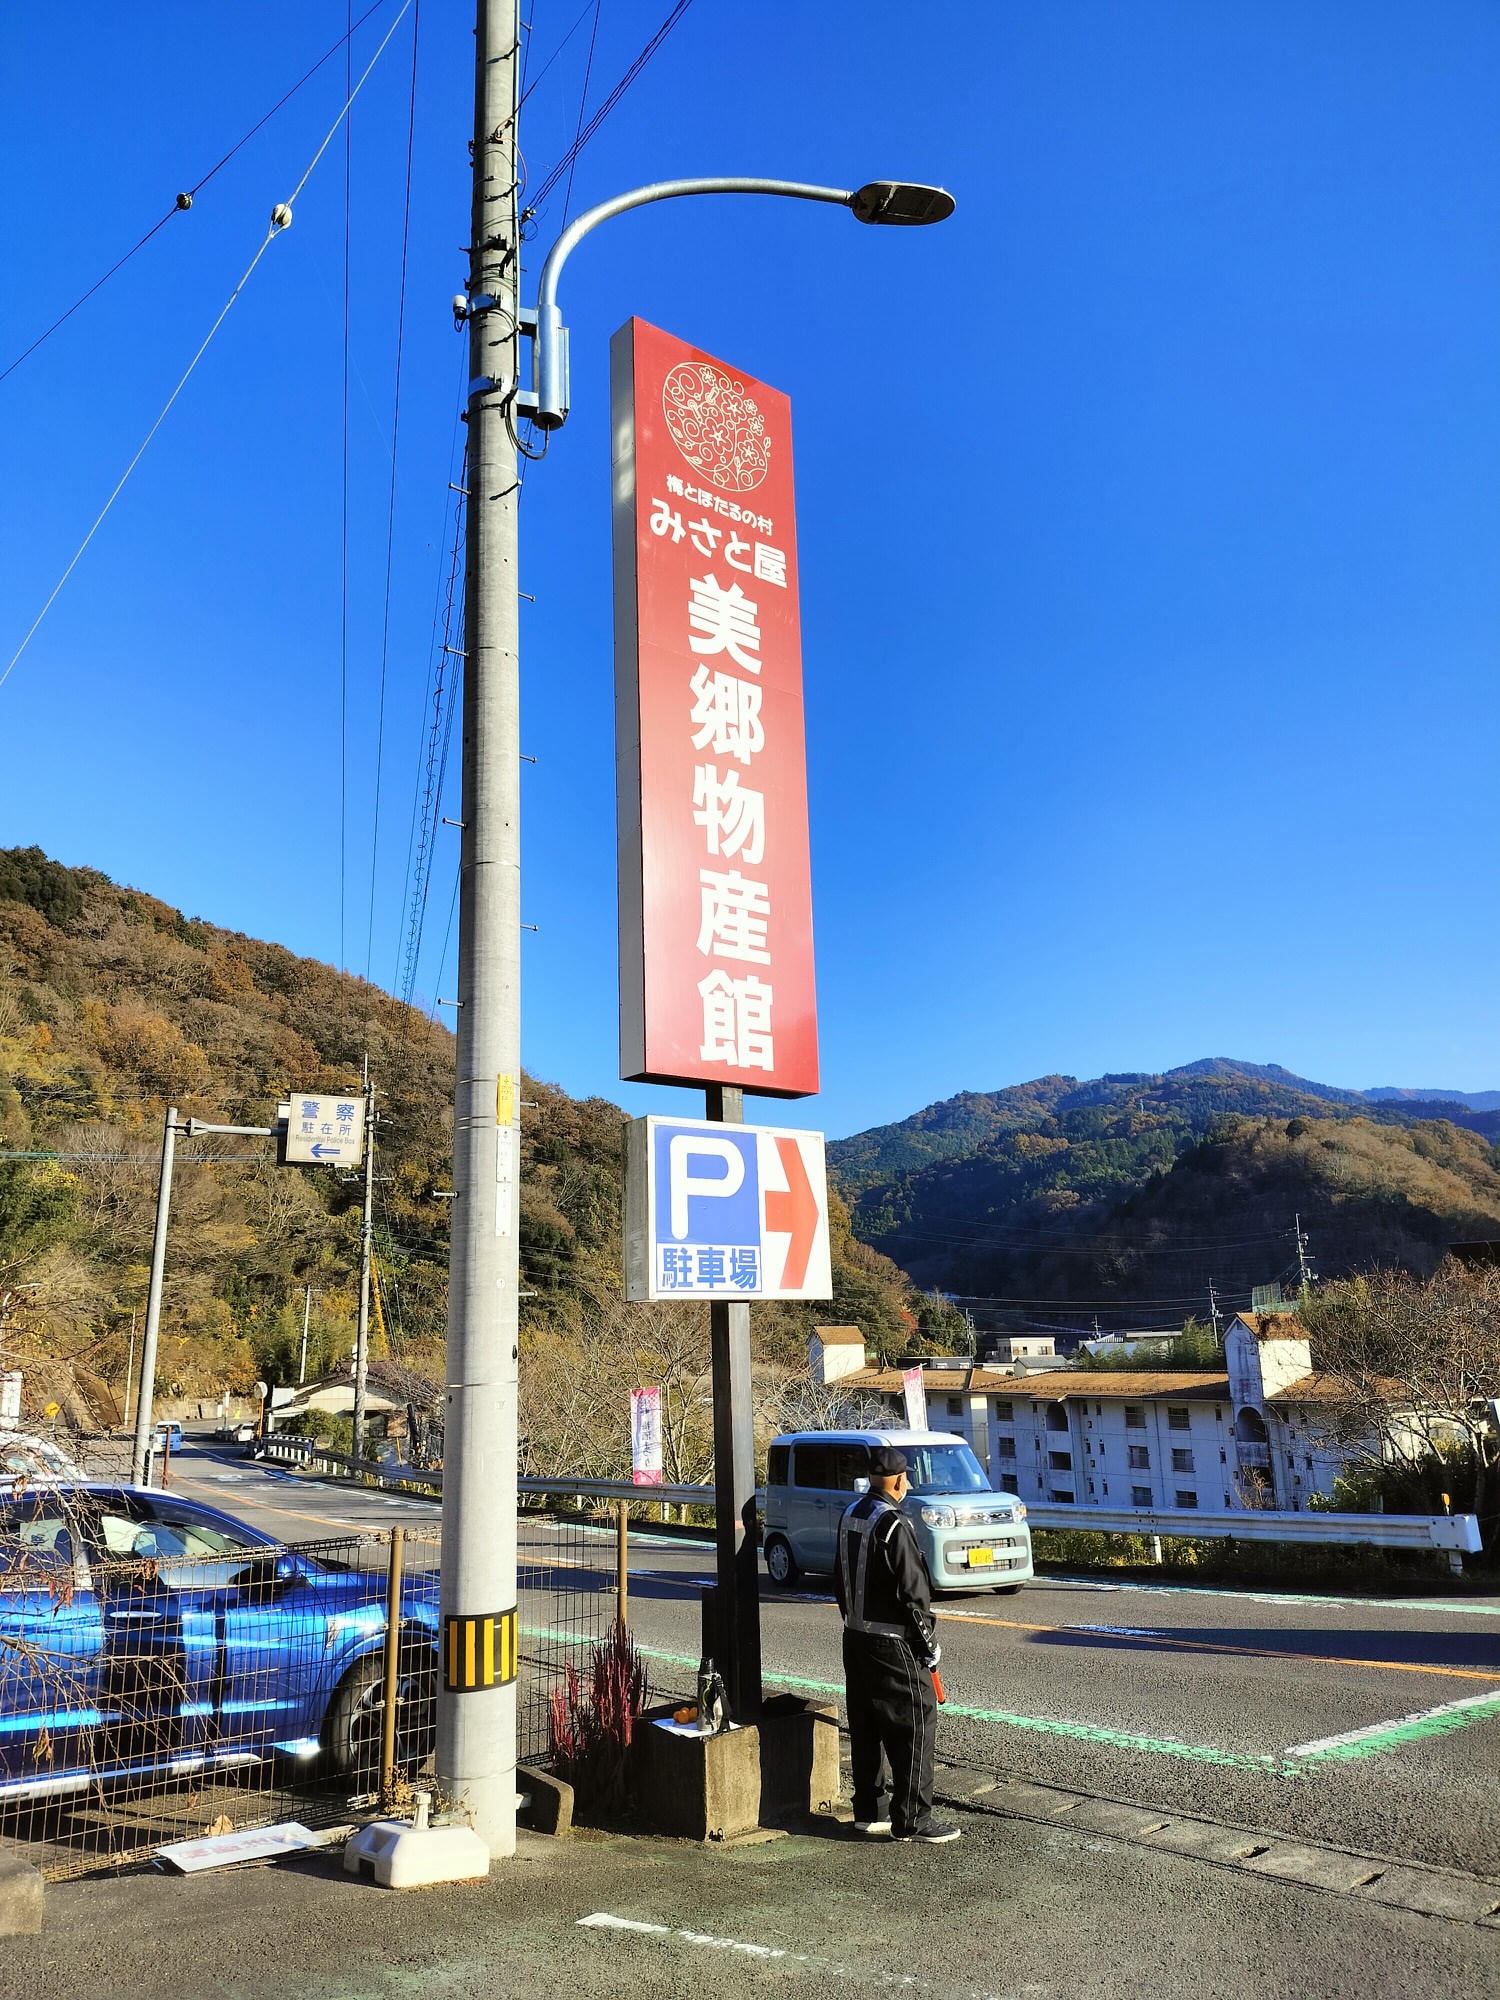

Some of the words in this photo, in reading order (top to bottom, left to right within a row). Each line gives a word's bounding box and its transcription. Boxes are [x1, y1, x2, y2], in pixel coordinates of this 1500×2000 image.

[650, 497, 787, 588] みさと屋
[666, 474, 773, 536] 梅とほたるの村
[687, 573, 775, 1071] 美郷物産館
[301, 1121, 352, 1136] 駐在所
[669, 1134, 746, 1241] P
[661, 1246, 758, 1290] 駐車場
